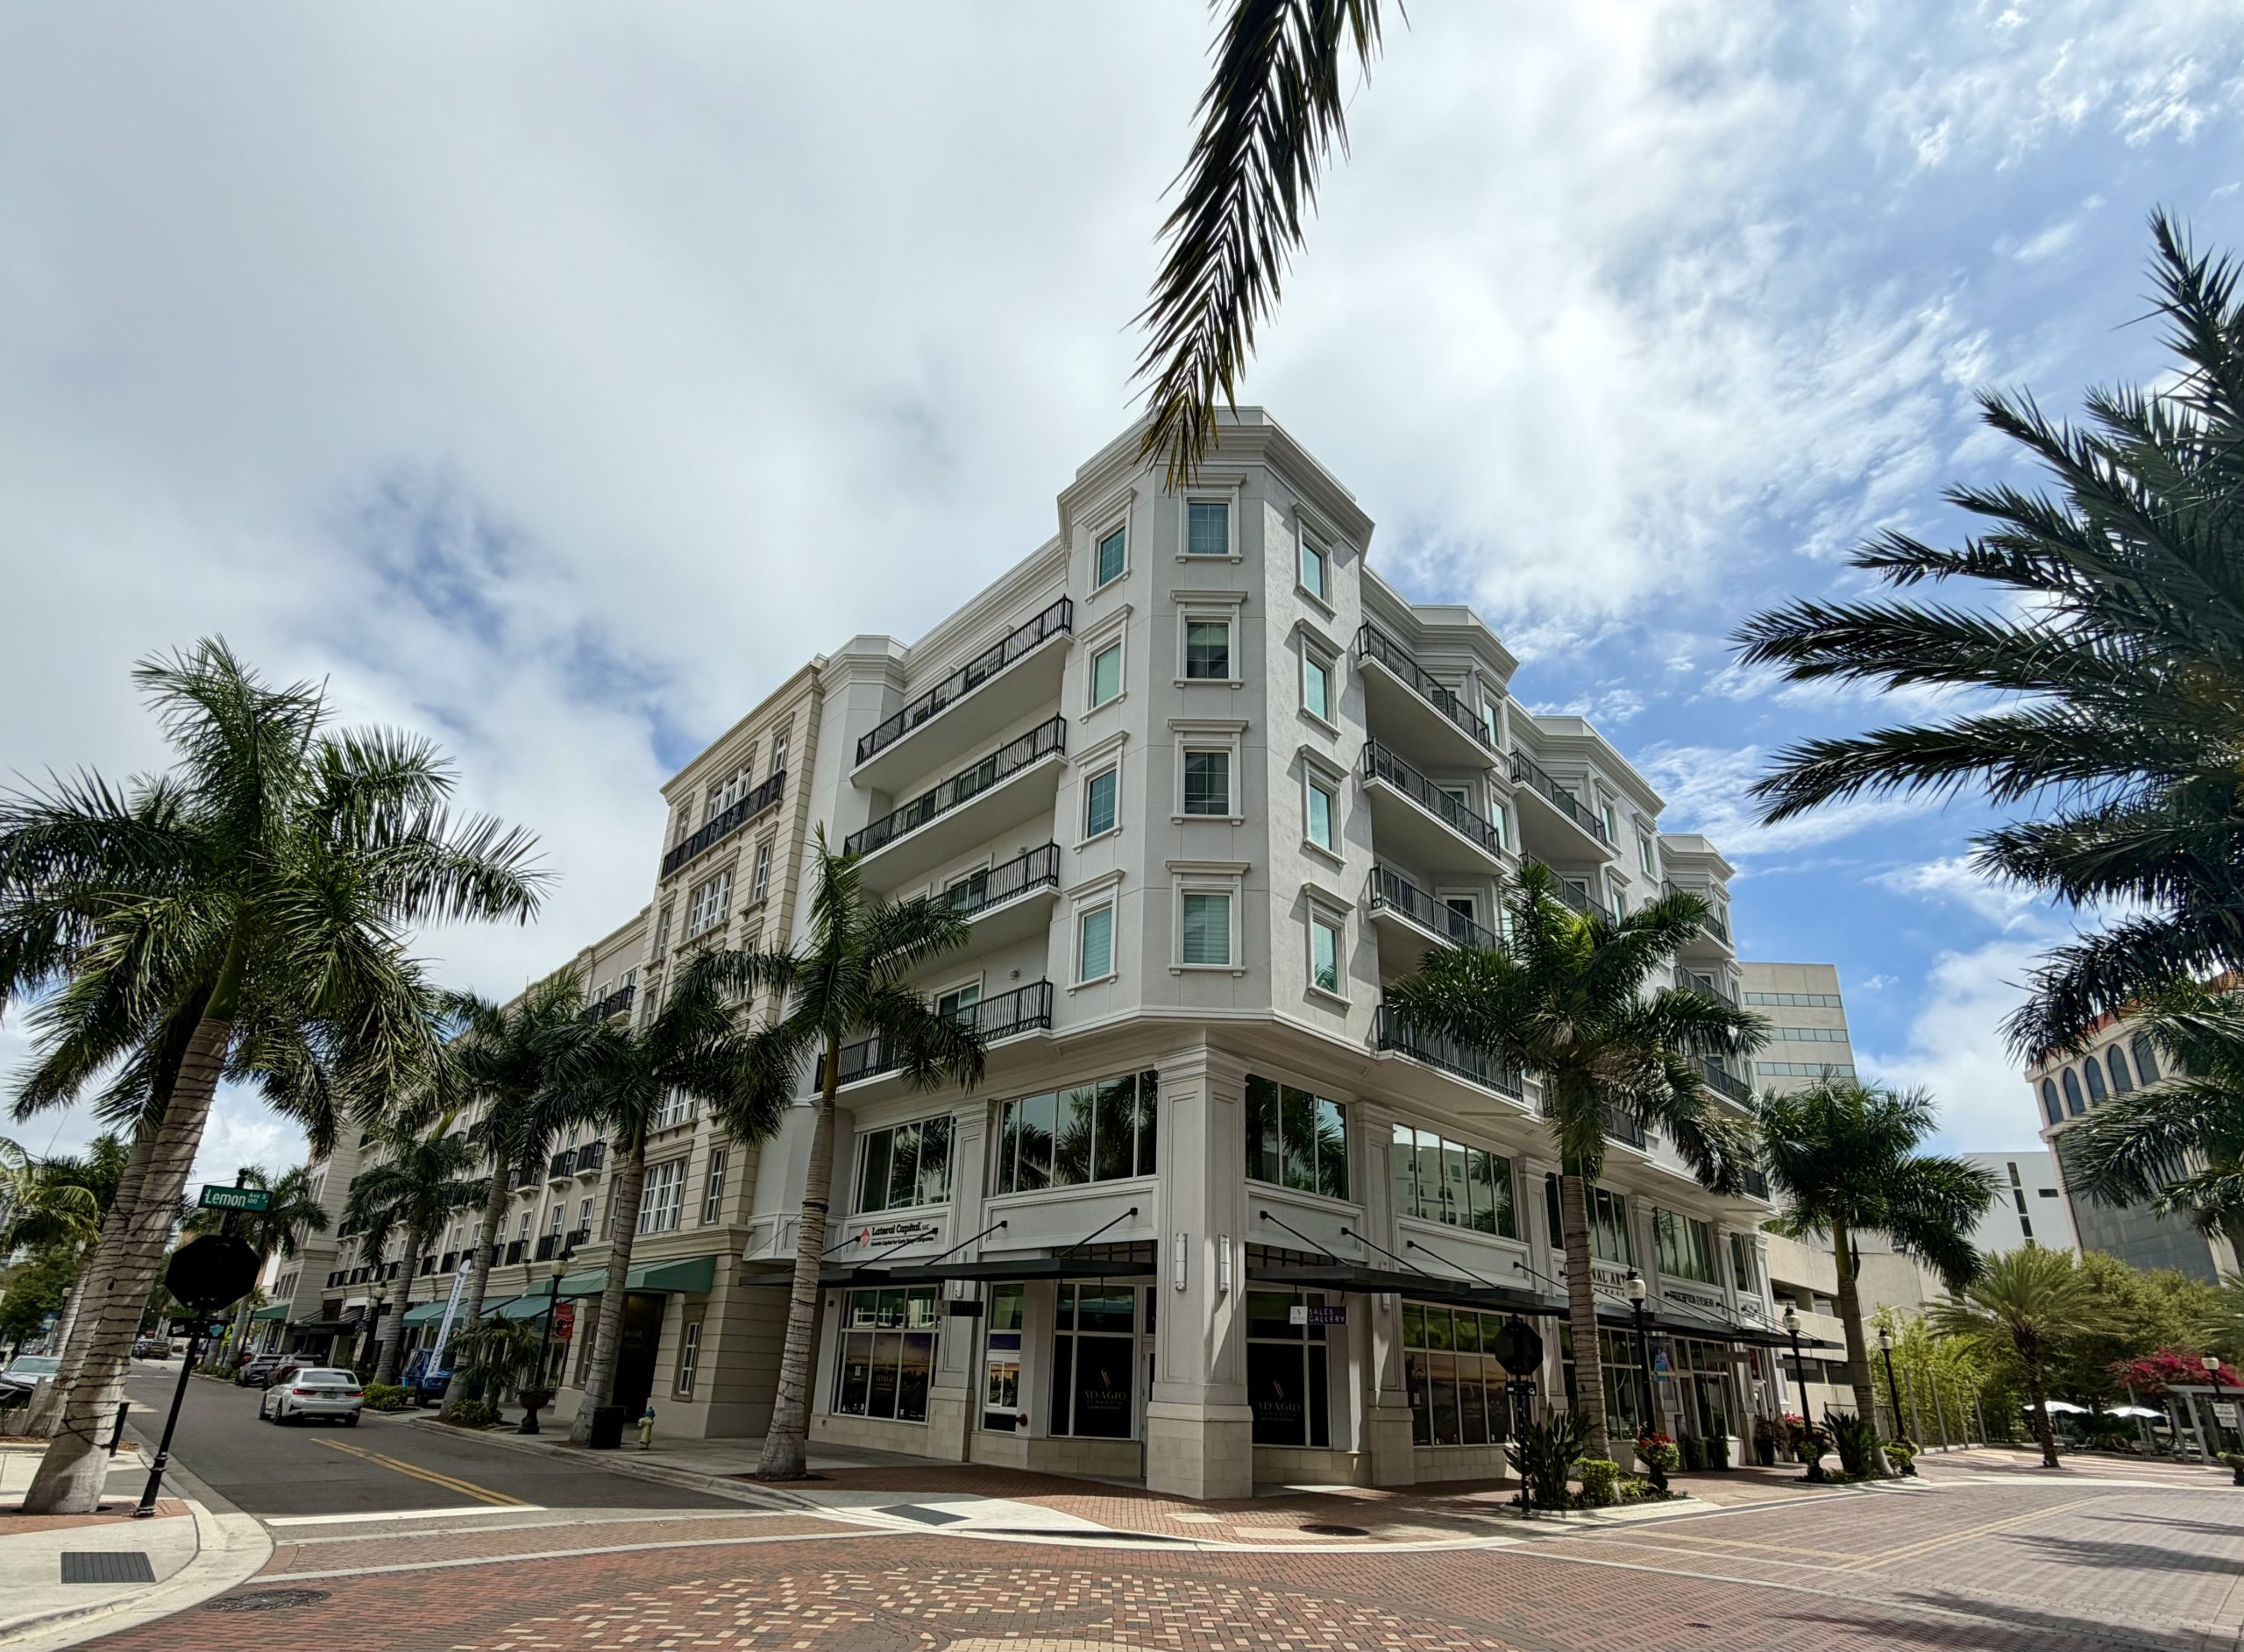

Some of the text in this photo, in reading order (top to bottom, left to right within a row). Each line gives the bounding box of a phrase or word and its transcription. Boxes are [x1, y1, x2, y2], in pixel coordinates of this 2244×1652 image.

[204, 1189, 246, 1208] Lemon
[872, 1225, 895, 1236] Lateral
[1591, 1268, 1608, 1283] NAL
[1084, 1391, 1126, 1400] ADAGIO
[1258, 1402, 1301, 1412] ADAGIO
